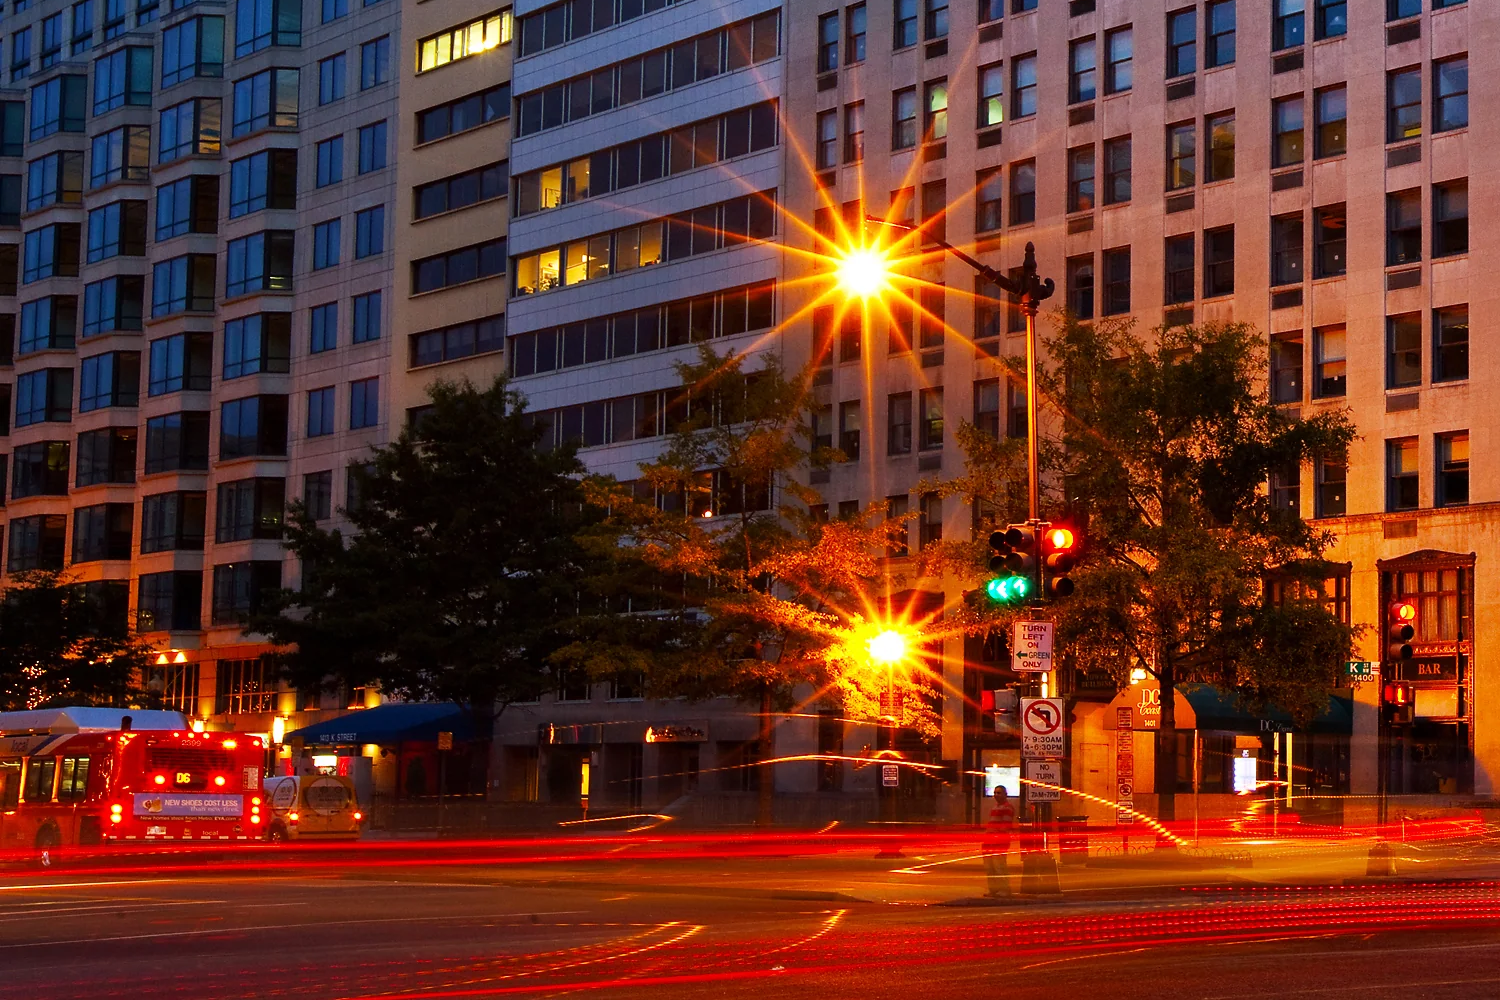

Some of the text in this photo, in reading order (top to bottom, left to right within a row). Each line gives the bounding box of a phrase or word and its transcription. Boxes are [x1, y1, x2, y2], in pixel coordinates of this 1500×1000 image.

[1022, 624, 1046, 632] TURN
[1028, 651, 1050, 659] GREEN
[1022, 660, 1042, 668] ONLY
[1350, 663, 1359, 673] K
[1418, 663, 1441, 675] BAR
[1354, 674, 1374, 682] 1400
[1141, 688, 1161, 705] DC
[1144, 719, 1156, 727] 1401
[1260, 718, 1274, 732] DC
[330, 733, 335, 741] K
[336, 732, 357, 742] STREET
[176, 772, 191, 784] D6
